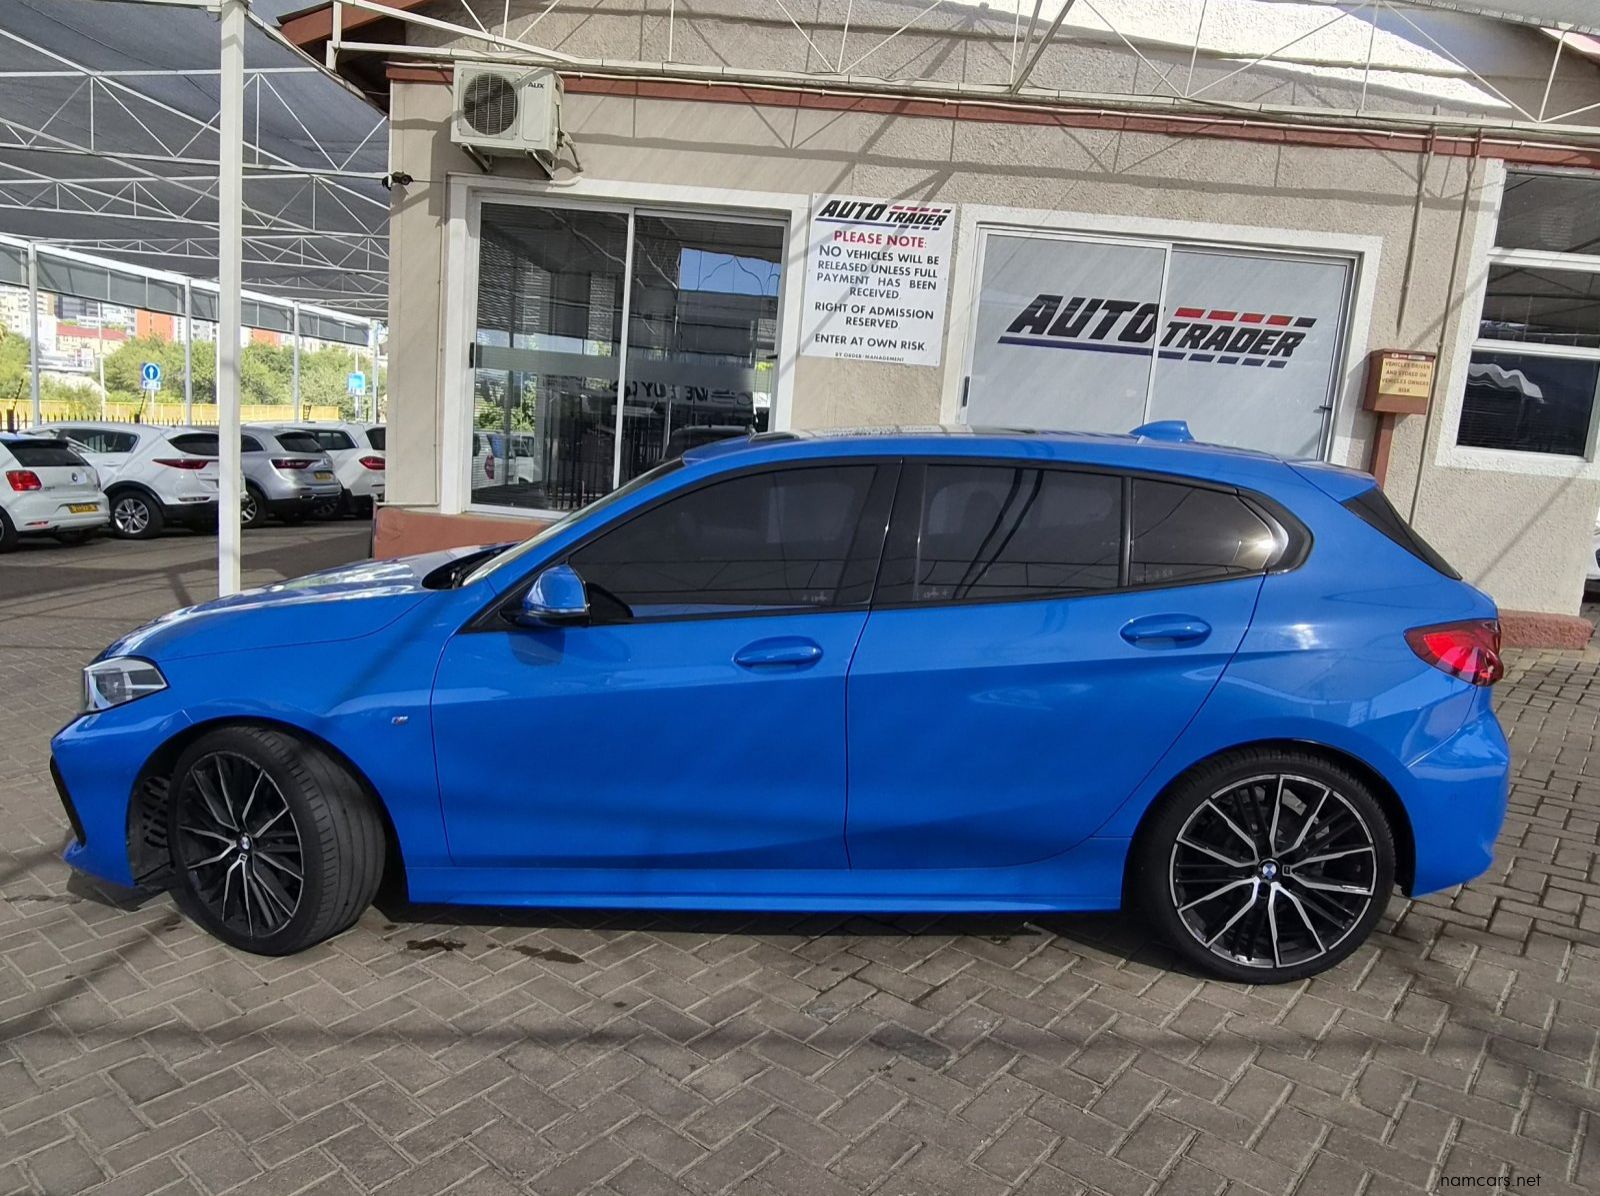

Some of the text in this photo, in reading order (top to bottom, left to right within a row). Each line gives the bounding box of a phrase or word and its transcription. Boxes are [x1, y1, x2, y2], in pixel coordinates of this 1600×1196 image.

[818, 200, 947, 227] AUTO TRADER
[834, 230, 882, 244] PLEASE
[819, 245, 939, 265] NO VEHICLES WILL BE
[818, 260, 938, 278] RELEASED UNLESS FULL
[817, 272, 936, 290] PAYMENT HAS BEEN
[815, 302, 934, 319] RIGHT OF ADMISSION
[1006, 294, 1307, 357] AUTO TRADER
[815, 333, 847, 344] ENTER
[851, 337, 863, 346] AT
[868, 338, 897, 349] OWN
